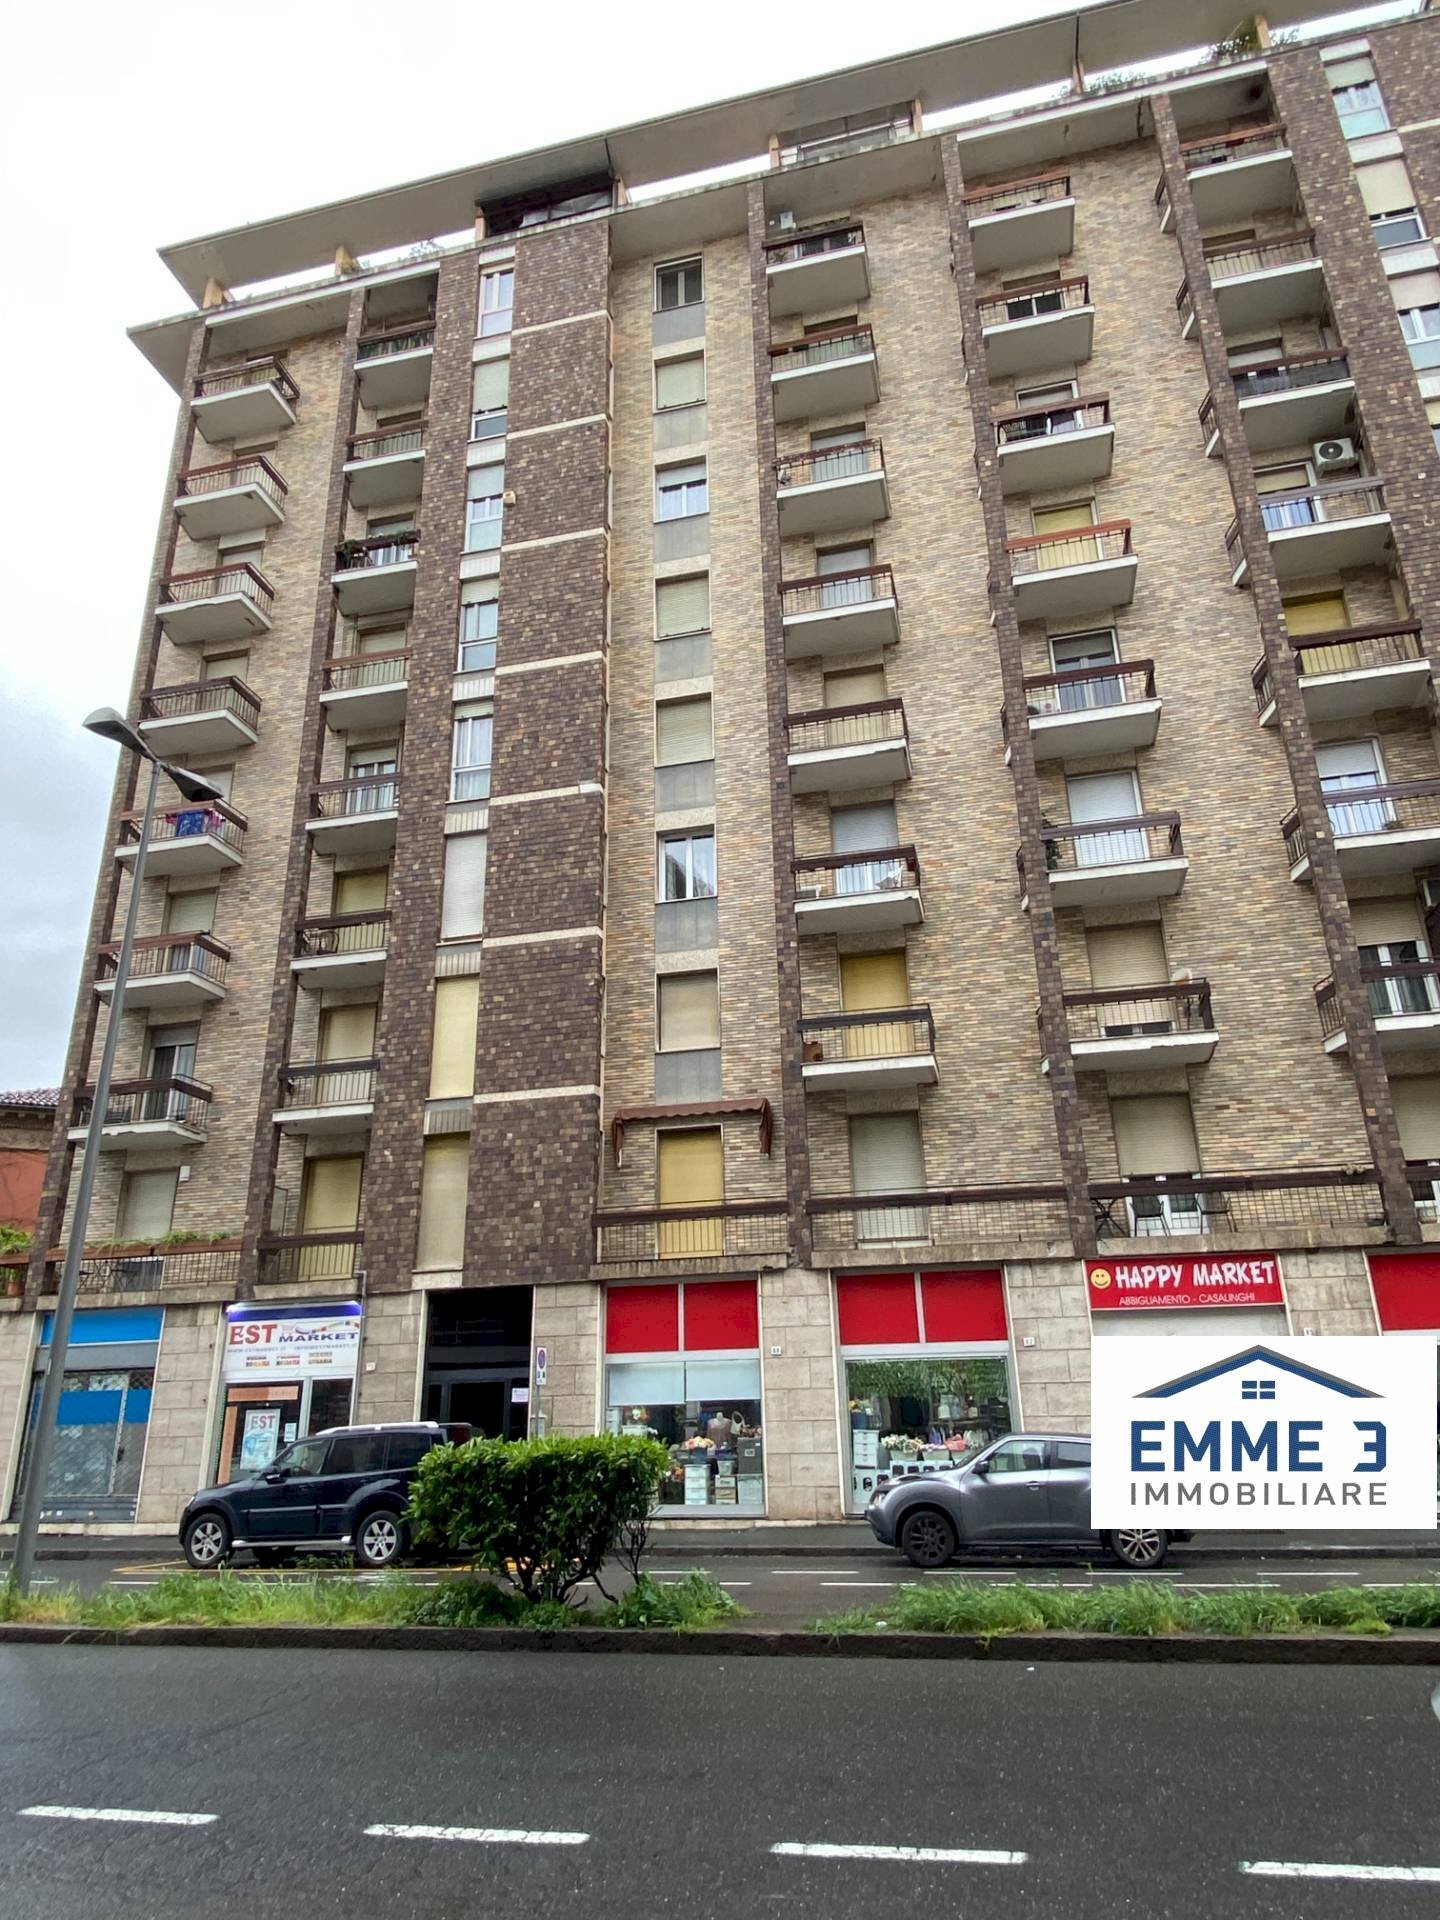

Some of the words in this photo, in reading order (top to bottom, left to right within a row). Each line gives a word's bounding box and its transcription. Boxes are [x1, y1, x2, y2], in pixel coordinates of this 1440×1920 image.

[1115, 1264, 1183, 1289] HAPPY
[1192, 1260, 1275, 1287] MARKET
[1119, 1294, 1191, 1306] ABBIGLIAMENTO
[1199, 1292, 1256, 1304] CASALINGHI
[229, 1324, 277, 1345] EST
[279, 1332, 358, 1343] MARKET
[251, 1415, 275, 1429] EST
